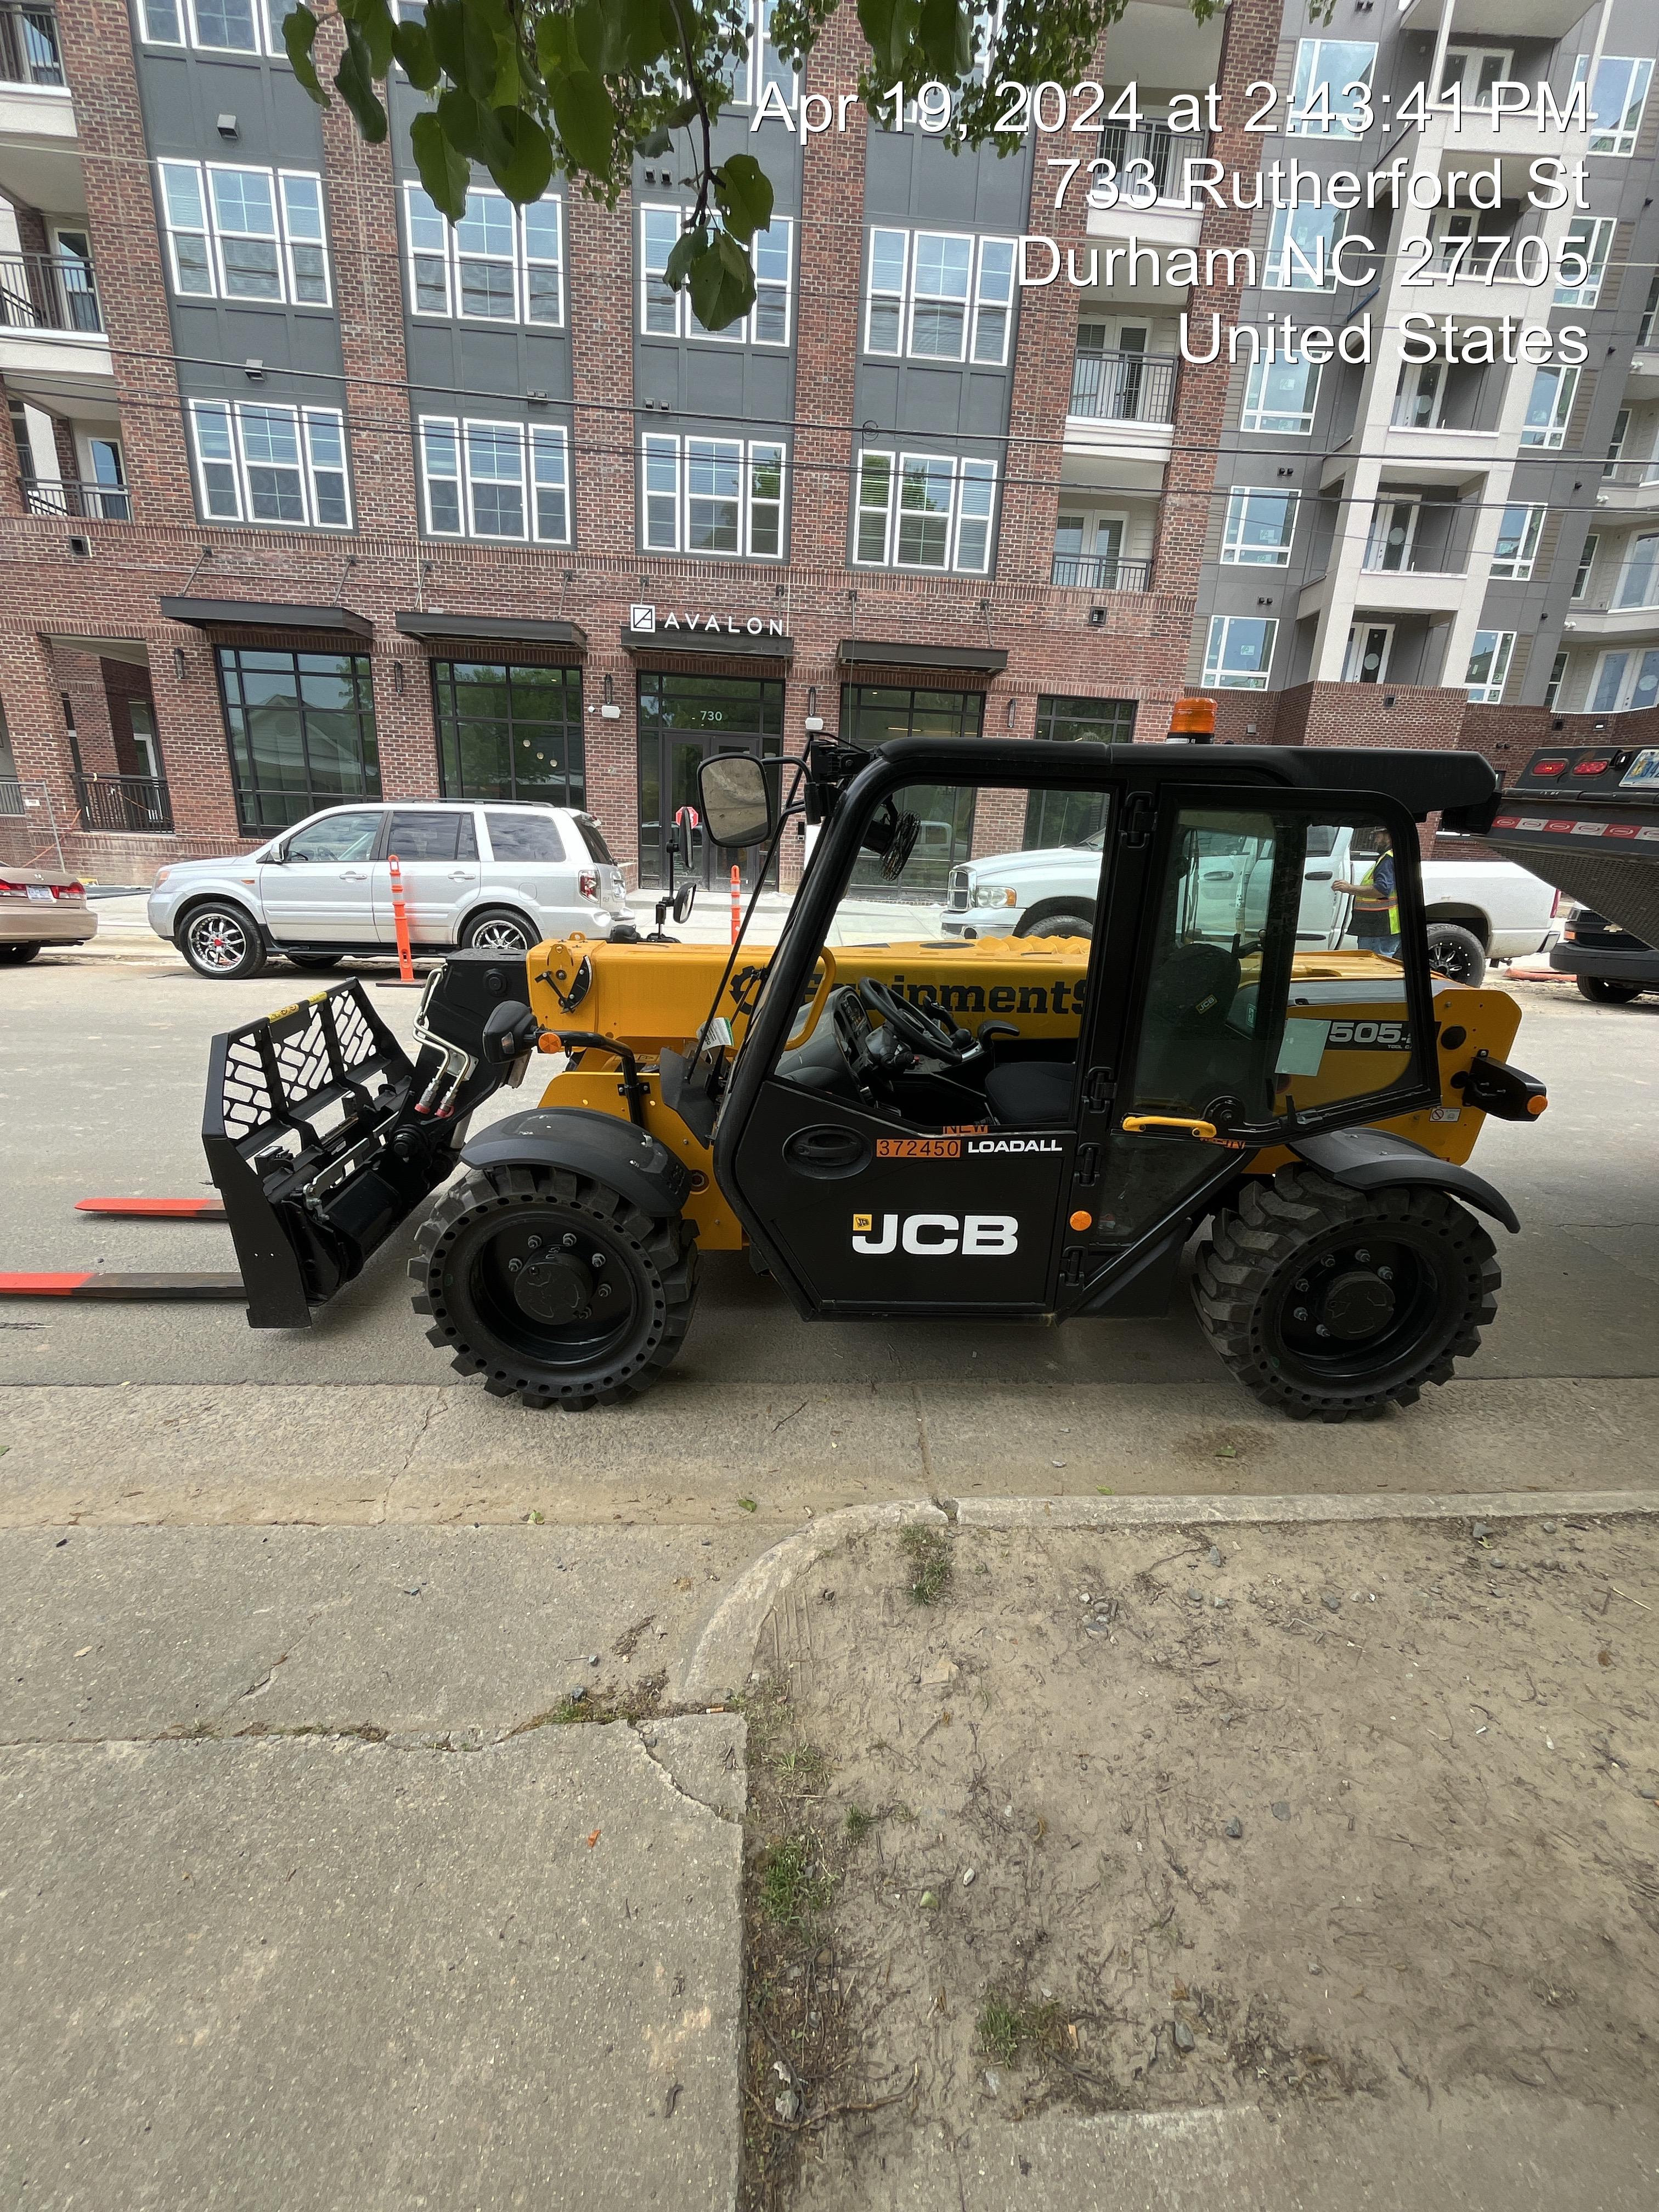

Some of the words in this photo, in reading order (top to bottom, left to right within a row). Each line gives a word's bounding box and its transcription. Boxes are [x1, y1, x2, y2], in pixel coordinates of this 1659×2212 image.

[664, 612, 783, 636] AVALON
[700, 710, 723, 722] 730
[1199, 997, 1215, 1011] JCB
[879, 1139, 959, 1156] 372450
[968, 1139, 1063, 1153] LOADALL
[852, 1214, 1019, 1255] JCB
